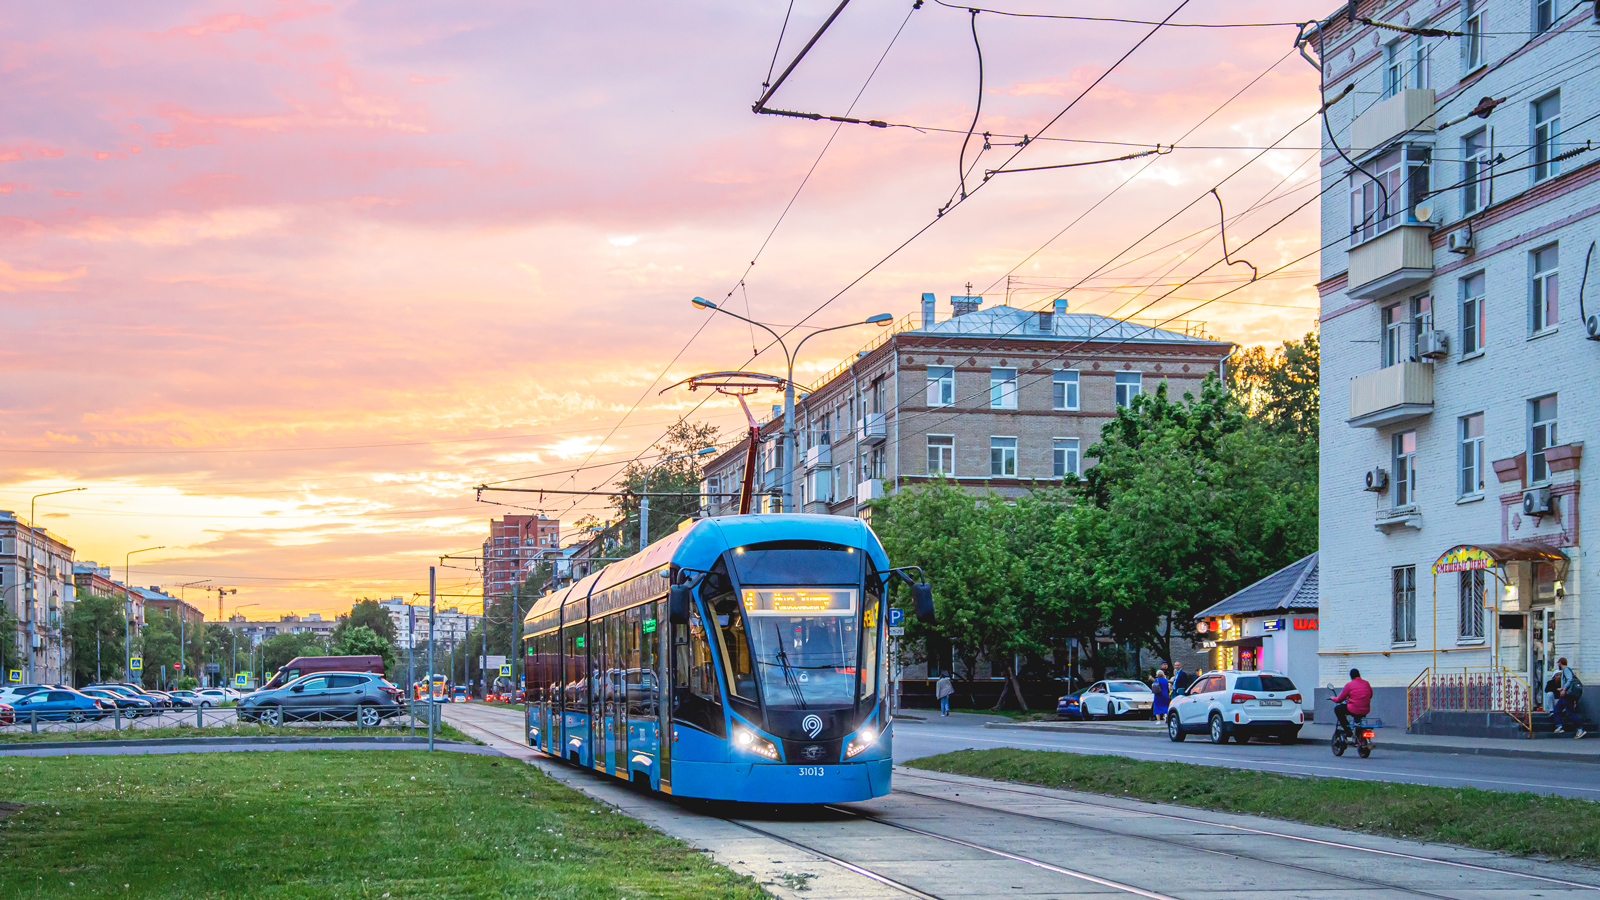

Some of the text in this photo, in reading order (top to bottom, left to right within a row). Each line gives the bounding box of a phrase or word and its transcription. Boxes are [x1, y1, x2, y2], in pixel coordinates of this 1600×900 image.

[1436, 558, 1488, 574] СМЕШНЫЕ ЦЕНЫ
[798, 767, 825, 777] 31013
